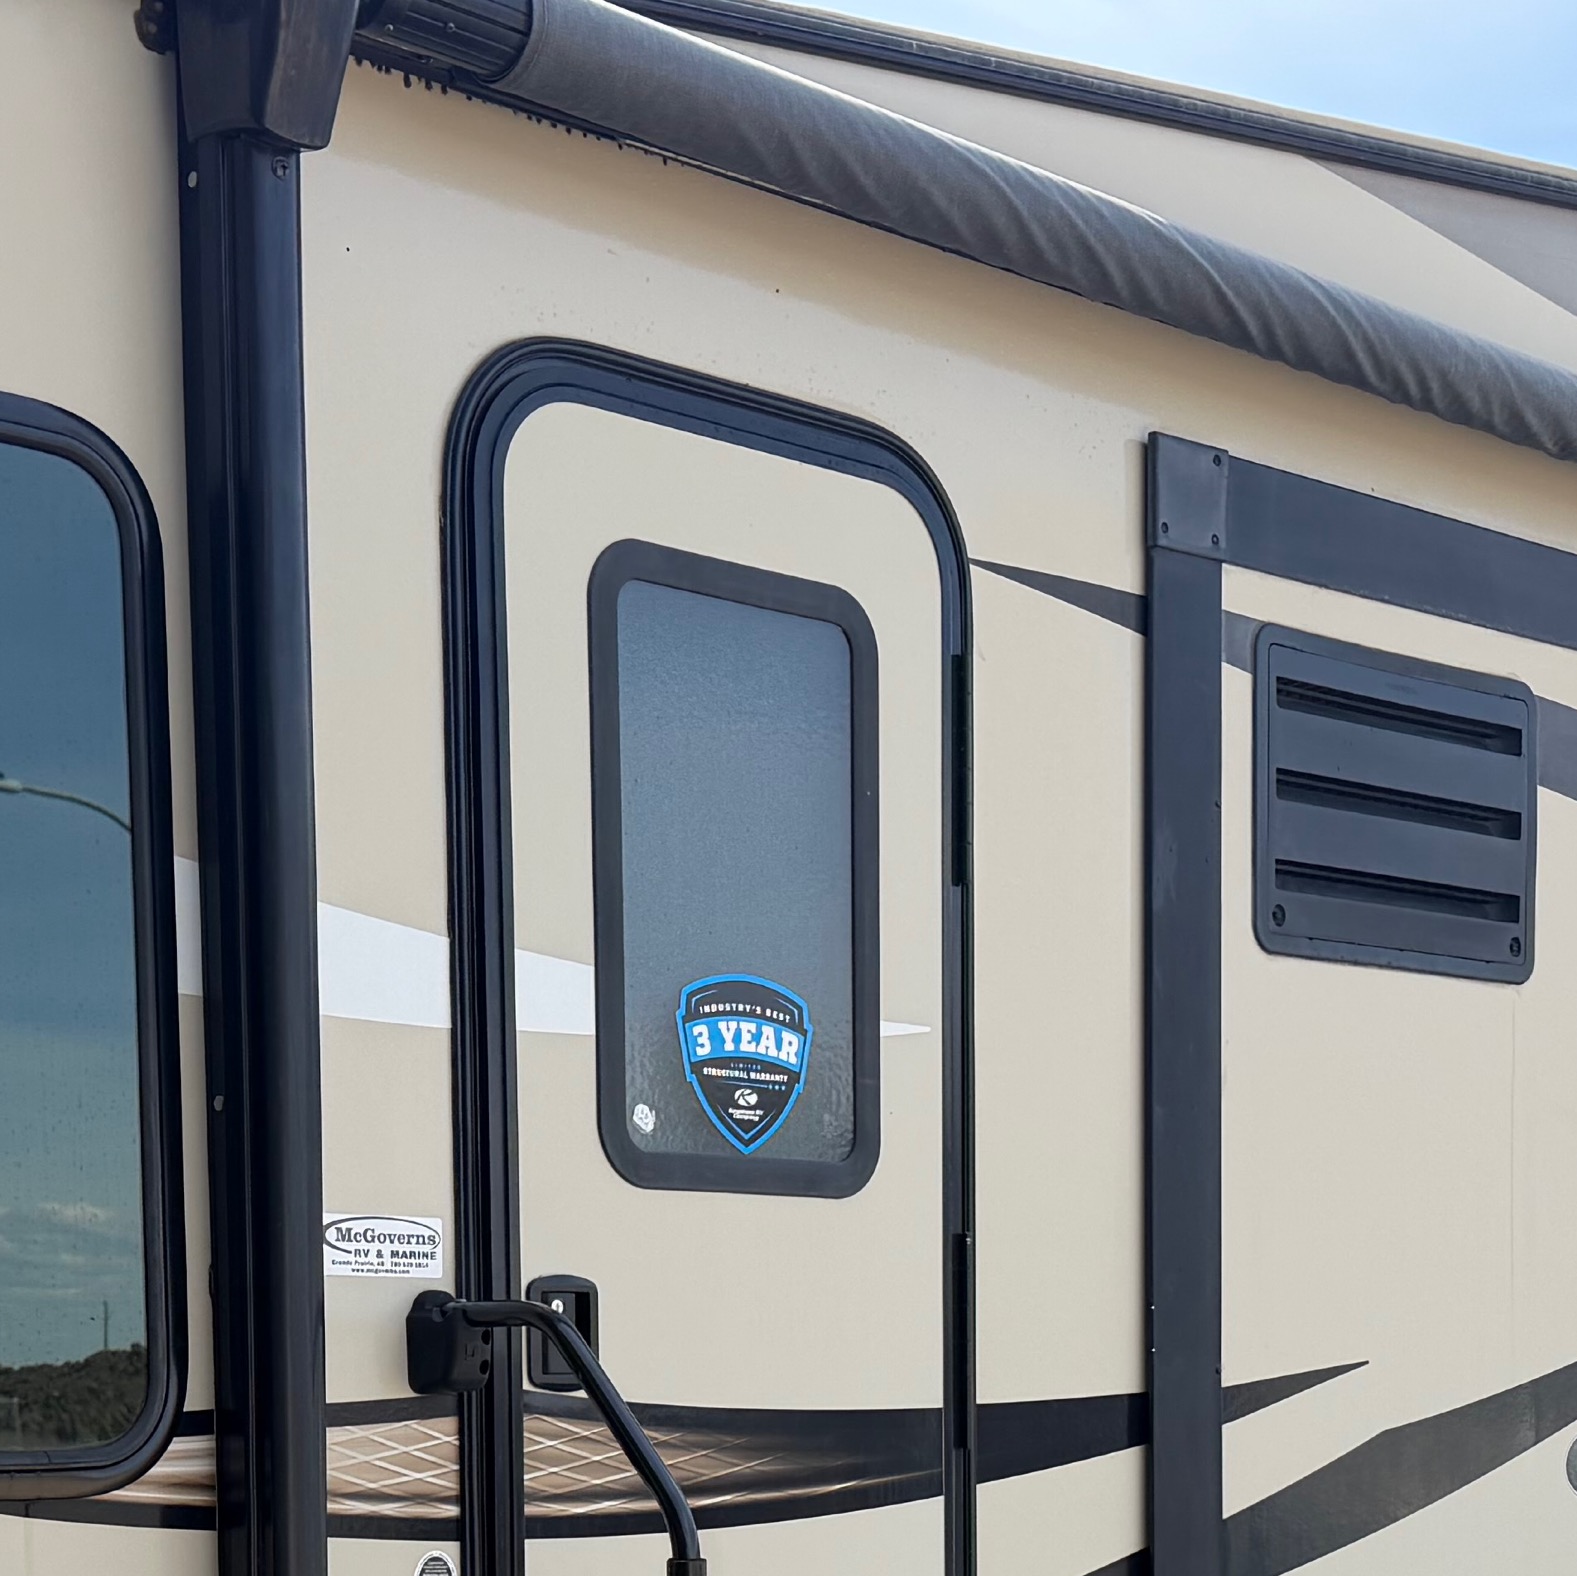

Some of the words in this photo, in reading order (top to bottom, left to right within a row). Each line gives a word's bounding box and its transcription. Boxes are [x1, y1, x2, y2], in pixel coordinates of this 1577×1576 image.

[699, 1003, 761, 1014] INDUSTRY'S
[765, 1008, 790, 1023] BEST
[692, 1024, 712, 1056] 3
[717, 1021, 799, 1065] YEAR
[702, 1067, 749, 1079] STRUCTURAL
[749, 1071, 789, 1083] WARRANTY
[334, 1226, 437, 1246] McGoverns
[353, 1248, 370, 1258] RV
[375, 1249, 384, 1259] &
[390, 1249, 438, 1261] MARINE
